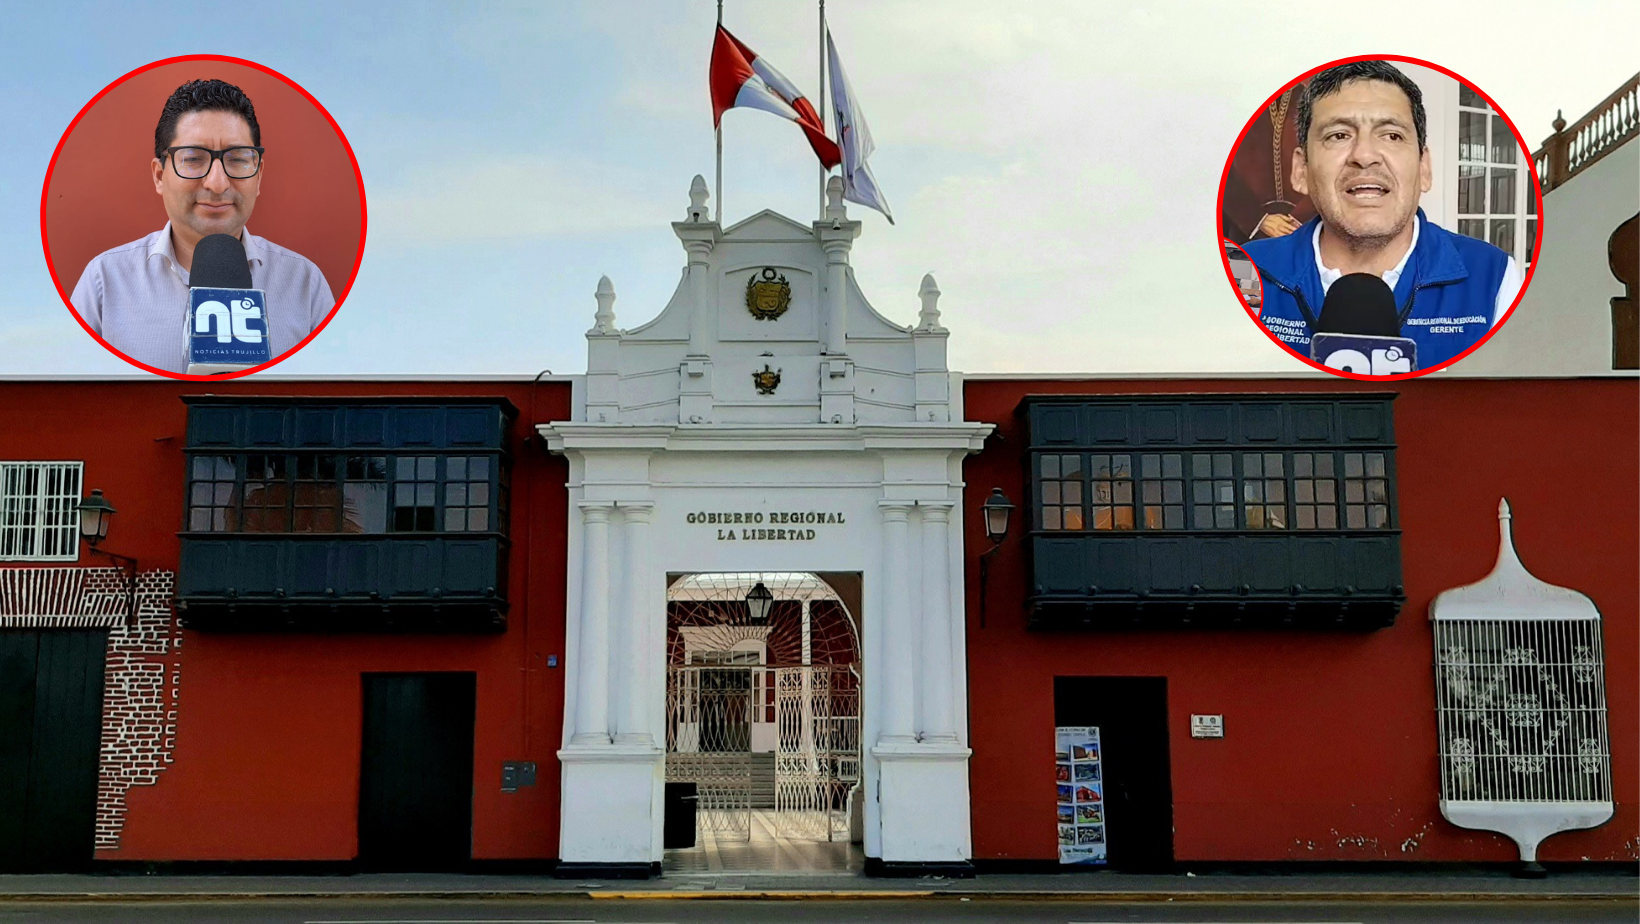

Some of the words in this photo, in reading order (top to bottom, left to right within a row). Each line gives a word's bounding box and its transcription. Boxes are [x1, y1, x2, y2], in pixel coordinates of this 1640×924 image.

[1266, 316, 1306, 328] GOBIERNO
[1430, 326, 1464, 334] GERENTE
[1274, 333, 1311, 345] IBERTAD
[686, 512, 764, 524] GOBIERNO
[769, 512, 846, 524] REGIONAL
[717, 529, 736, 541] LA
[742, 529, 816, 541] LIBERTAD
